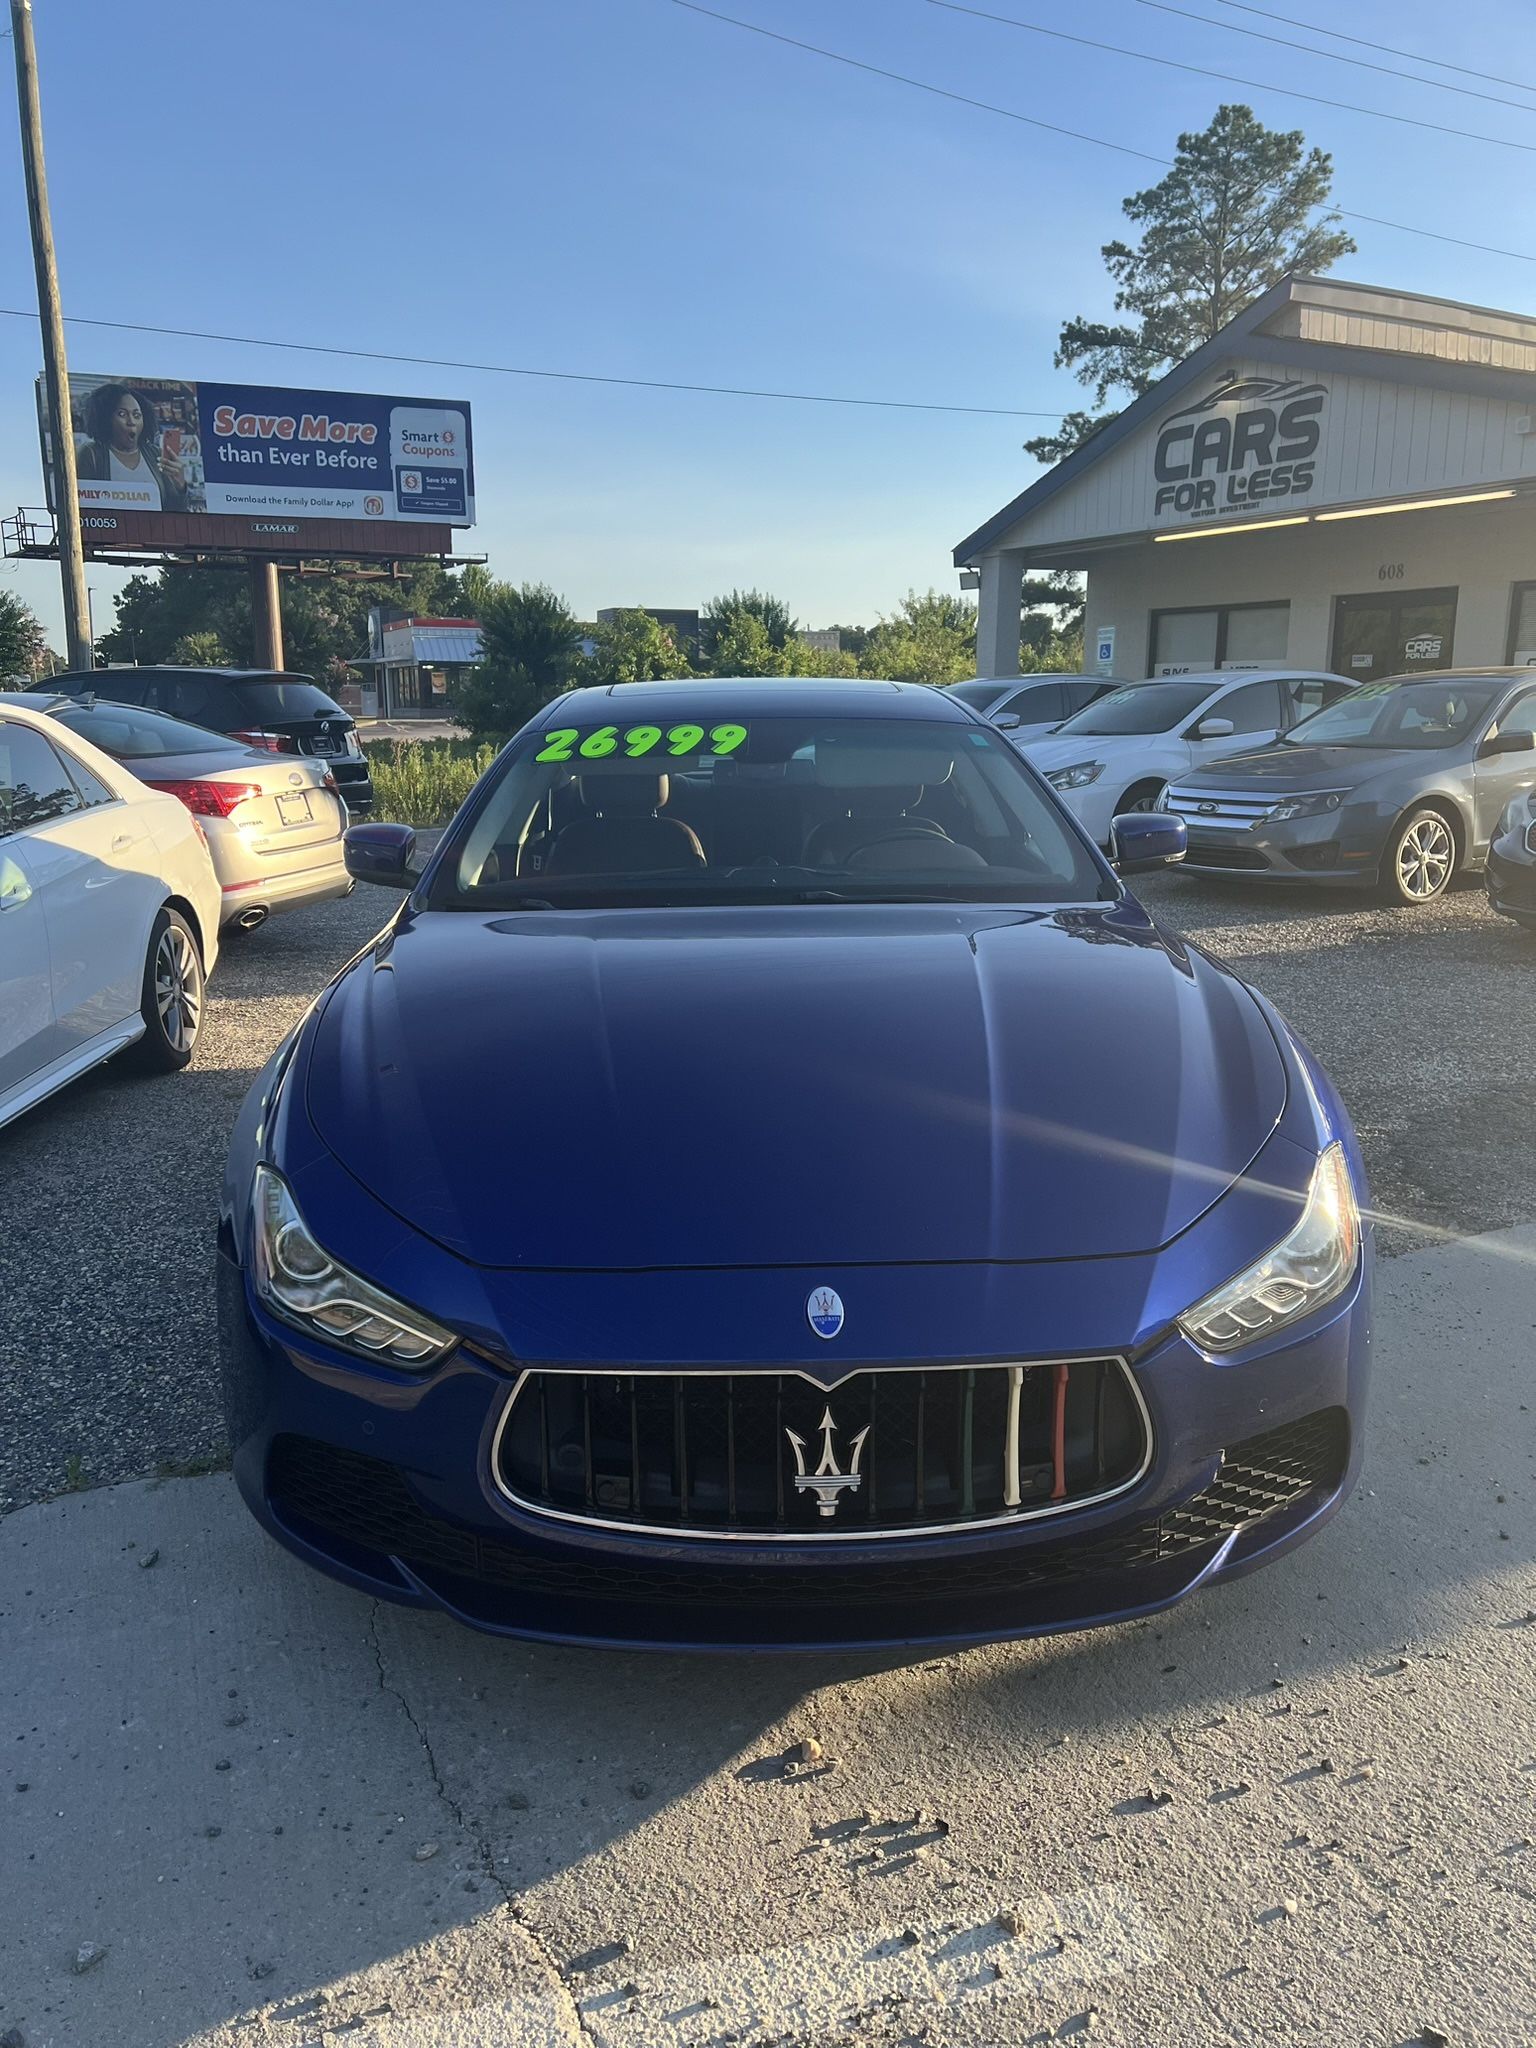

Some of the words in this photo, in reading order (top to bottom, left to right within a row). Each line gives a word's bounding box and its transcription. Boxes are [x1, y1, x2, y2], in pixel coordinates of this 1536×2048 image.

[161, 381, 181, 391] TIME
[213, 405, 296, 440] Save
[298, 414, 378, 445] More
[401, 429, 439, 443] Smart
[1154, 395, 1324, 483] CARS
[217, 443, 263, 464] than
[269, 447, 310, 466] Ever
[316, 449, 378, 469] Before
[402, 443, 456, 459] Coupons
[1154, 479, 1216, 516] FOR
[1226, 461, 1316, 503] LESS
[225, 494, 267, 504] Download
[268, 496, 282, 504] the
[283, 497, 308, 507] Family
[310, 498, 334, 506] Dollar
[336, 500, 355, 509] App!
[255, 524, 296, 533] LAMAR
[1378, 563, 1405, 580] 608
[1405, 640, 1441, 652] CARS
[535, 723, 748, 763] 26999
